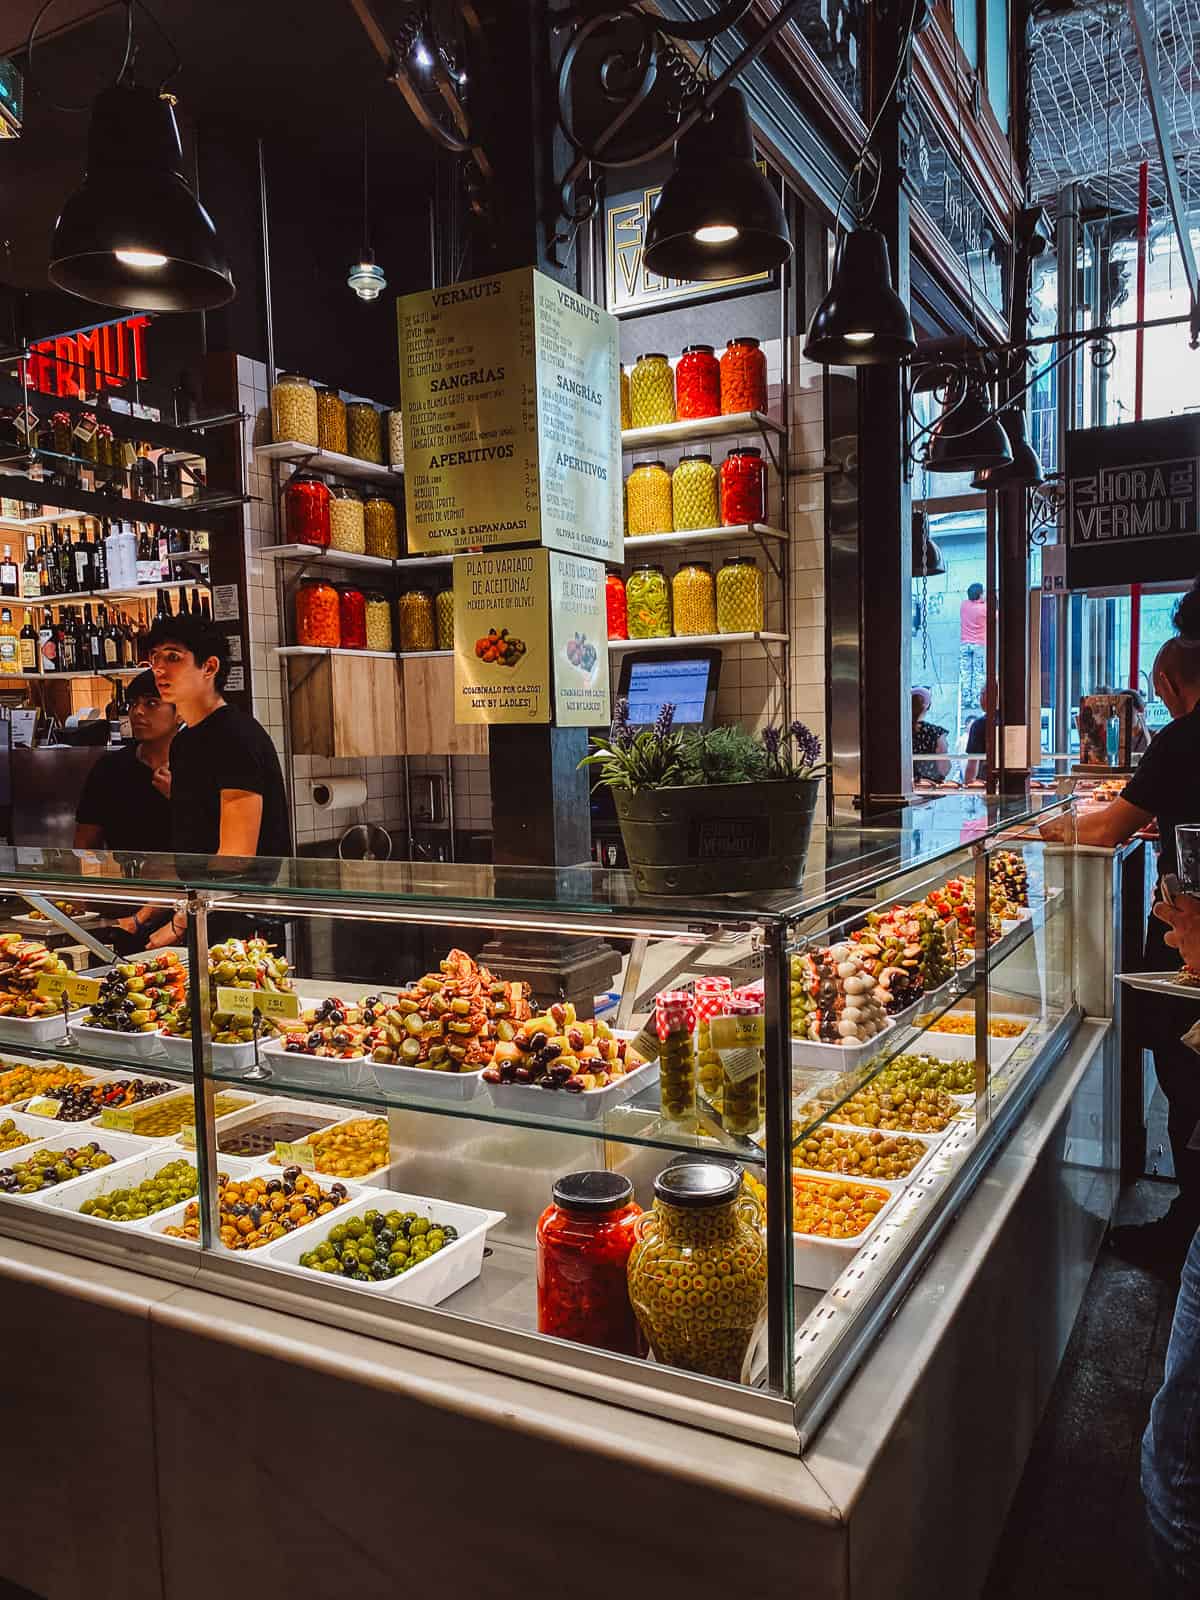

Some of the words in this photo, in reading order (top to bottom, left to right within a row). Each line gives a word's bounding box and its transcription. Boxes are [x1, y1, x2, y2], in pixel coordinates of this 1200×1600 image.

[432, 281, 503, 307] VERMUTS
[557, 289, 600, 324] VERMUTS
[430, 366, 505, 393] SANGRÍAS
[556, 374, 602, 405] SANGRÍAS
[429, 444, 515, 469] APERITIVOS
[556, 452, 607, 480] APERITIVOS
[1075, 477, 1098, 505] LA
[1101, 467, 1167, 503] HORA
[1076, 497, 1192, 540] VERMUT
[428, 527, 458, 539] OLIVAS
[466, 560, 494, 576] PLATO
[495, 557, 534, 573] VARIADO
[472, 581, 483, 595] DE
[484, 577, 531, 594] ACEITUNAS
[467, 600, 486, 610] MIXED
[486, 598, 505, 609] PLATE
[514, 596, 535, 608] OLIVES
[503, 685, 516, 694] POR
[472, 699, 486, 708] MIX
[487, 699, 497, 708] BY
